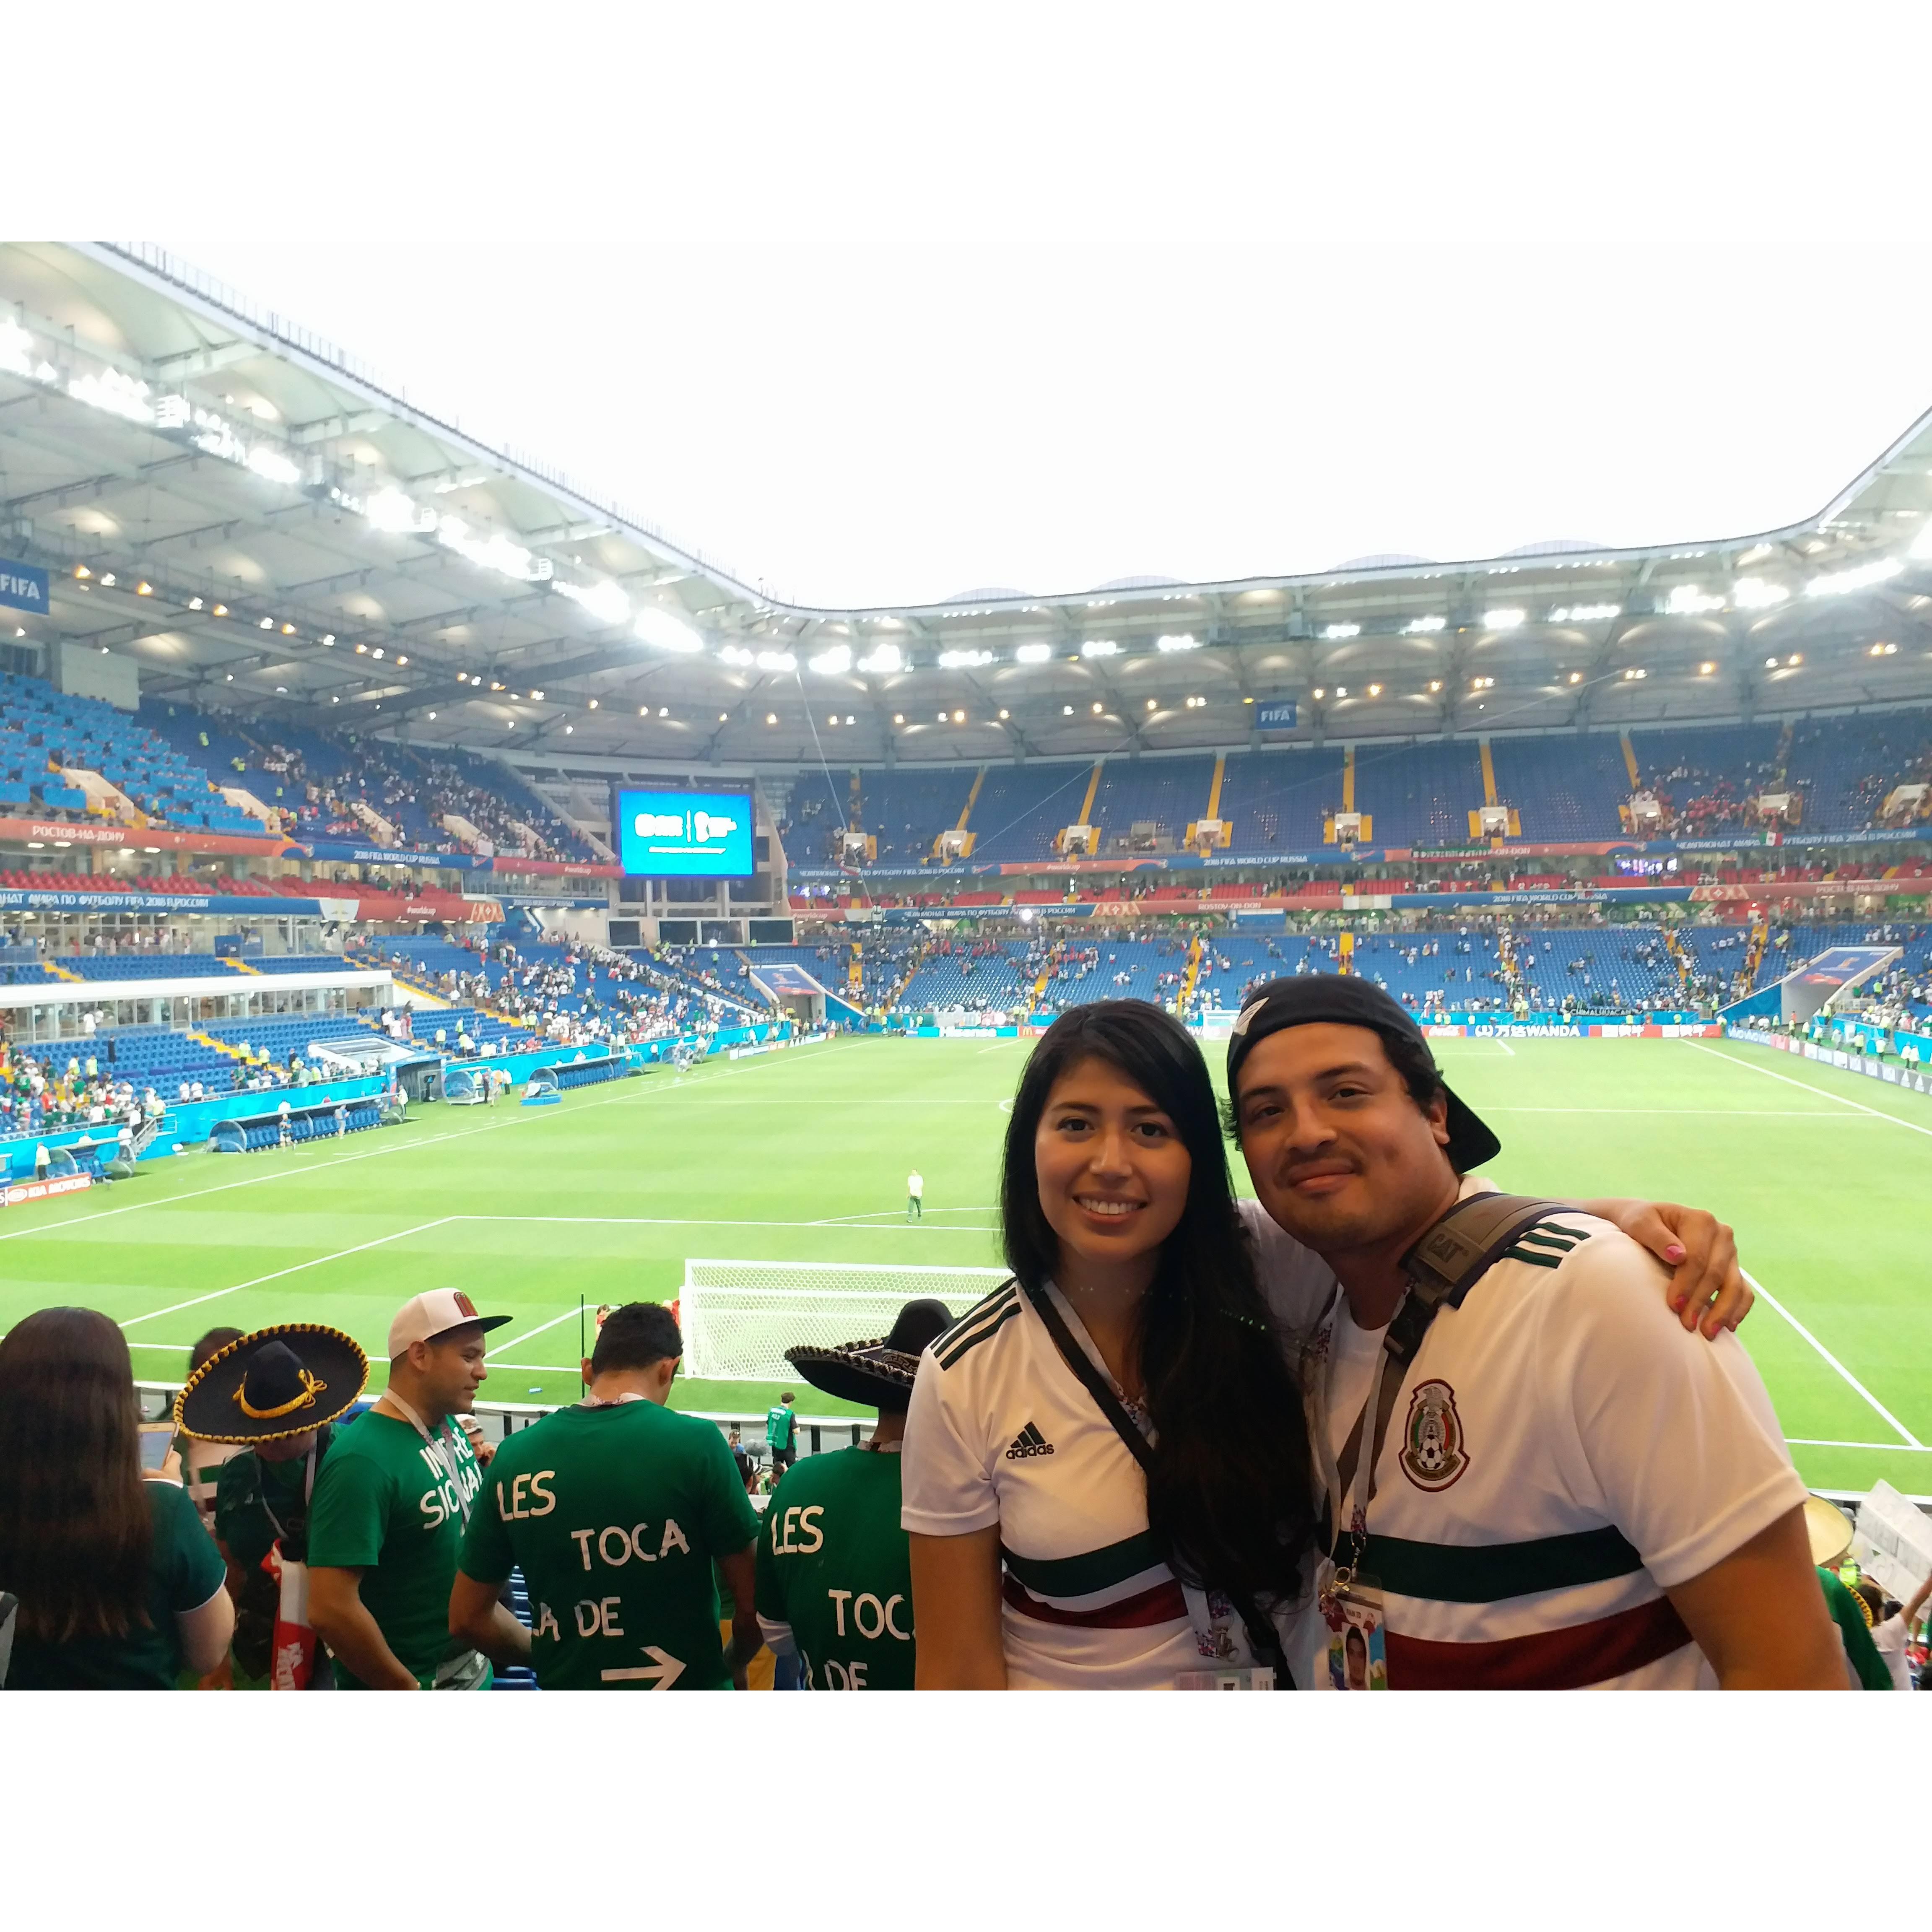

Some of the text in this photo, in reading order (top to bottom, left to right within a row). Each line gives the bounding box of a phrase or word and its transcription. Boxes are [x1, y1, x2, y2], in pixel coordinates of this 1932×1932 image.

[0, 573, 40, 600] FIFA
[1261, 710, 1290, 722] FIFA
[0, 893, 24, 904] НАТ
[1526, 1025, 1581, 1037] WANDA
[48, 1176, 91, 1195] MOTORS
[1426, 1233, 1465, 1263] CAT
[1006, 1444, 1054, 1459] adidas
[497, 1470, 556, 1521] LES
[771, 1506, 825, 1555] LES
[571, 1519, 690, 1571] TOCA
[574, 1596, 625, 1637] DE
[828, 1589, 916, 1640] TOC
